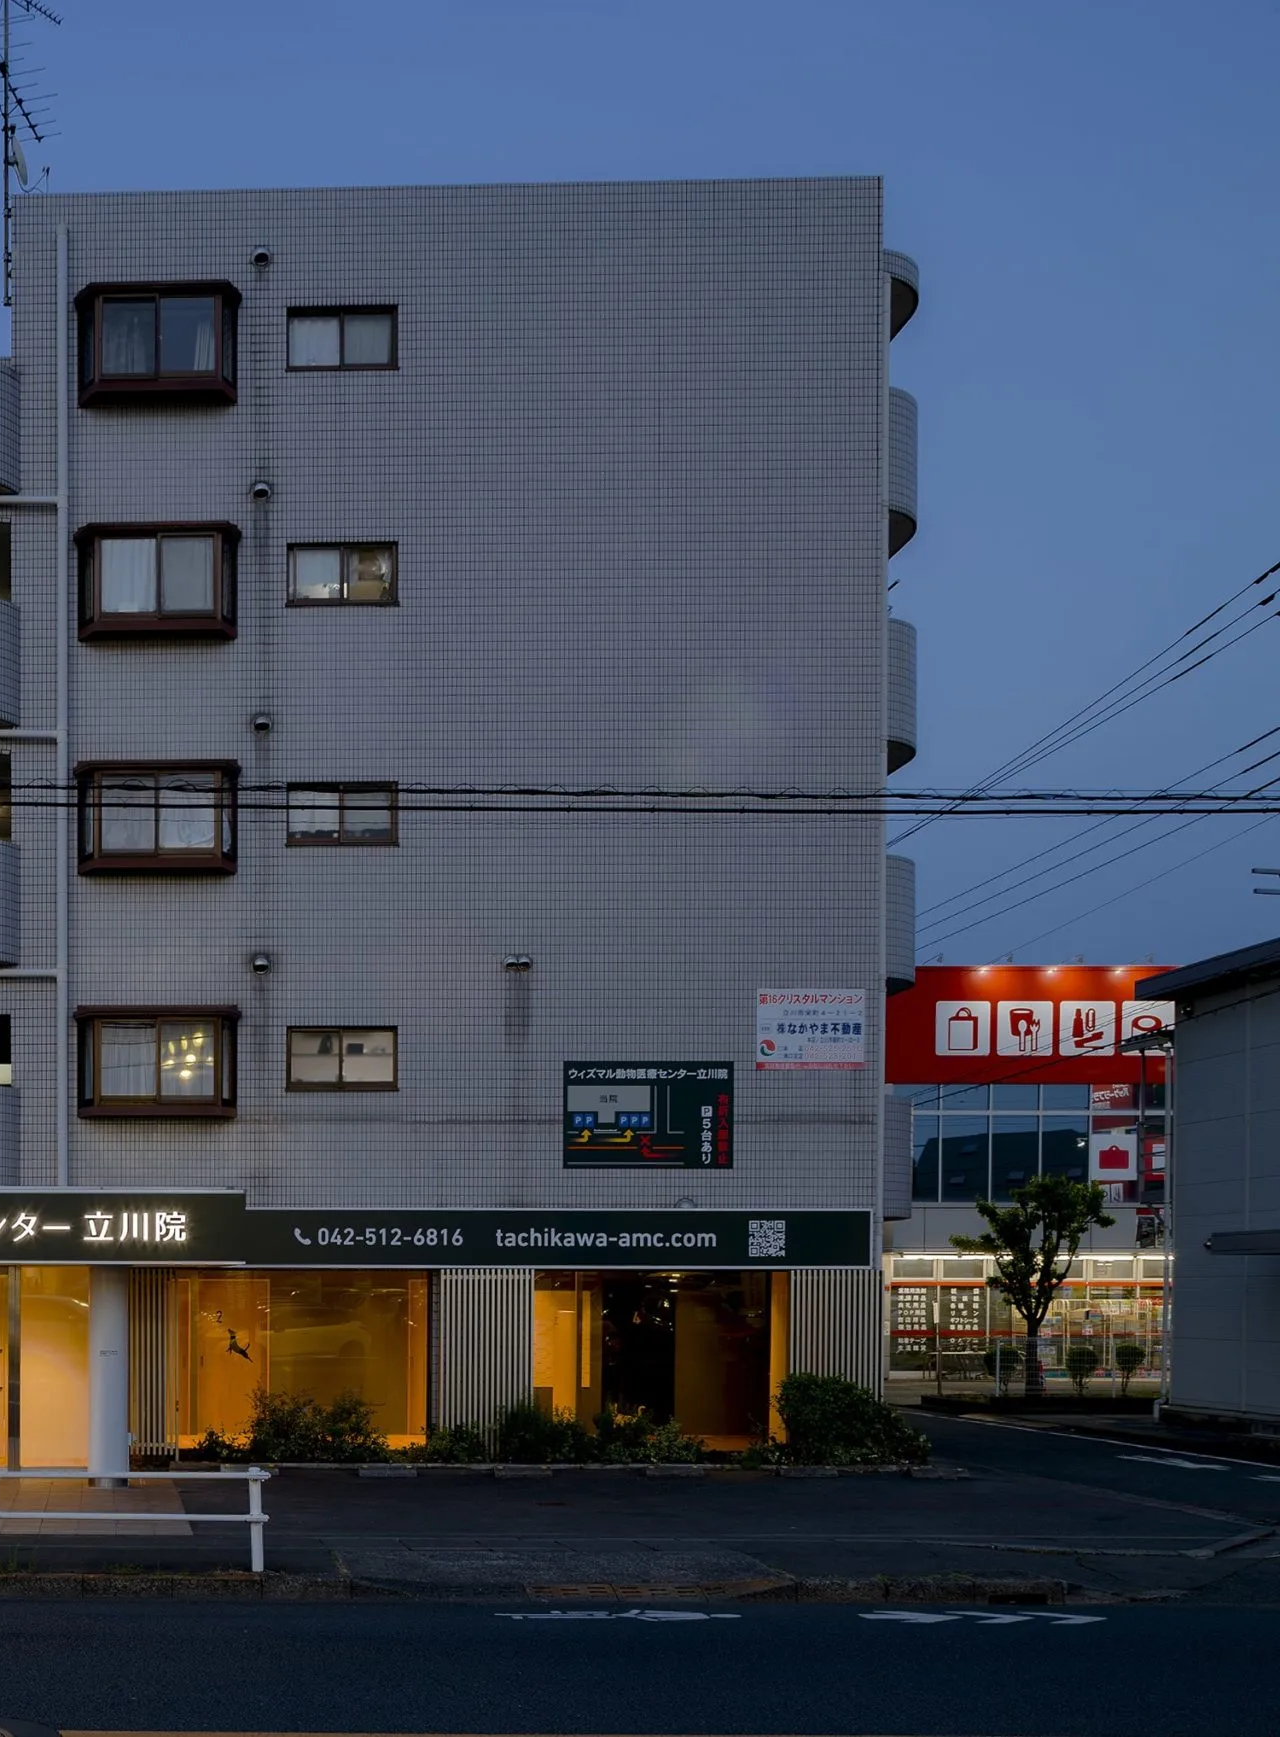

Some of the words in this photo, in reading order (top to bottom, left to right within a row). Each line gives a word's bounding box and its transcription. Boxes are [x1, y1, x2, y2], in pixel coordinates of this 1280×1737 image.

[759, 993, 863, 1005] 第16クリスタルマンション
[568, 1068, 728, 1080] ウィズマル動物医療センター立川院
[599, 1094, 618, 1103] 当院
[83, 1211, 188, 1242] 立川院
[317, 1227, 464, 1246] 042-512-6816
[495, 1227, 717, 1248] tachikawa-amc.com
[216, 1310, 222, 1323] 2
